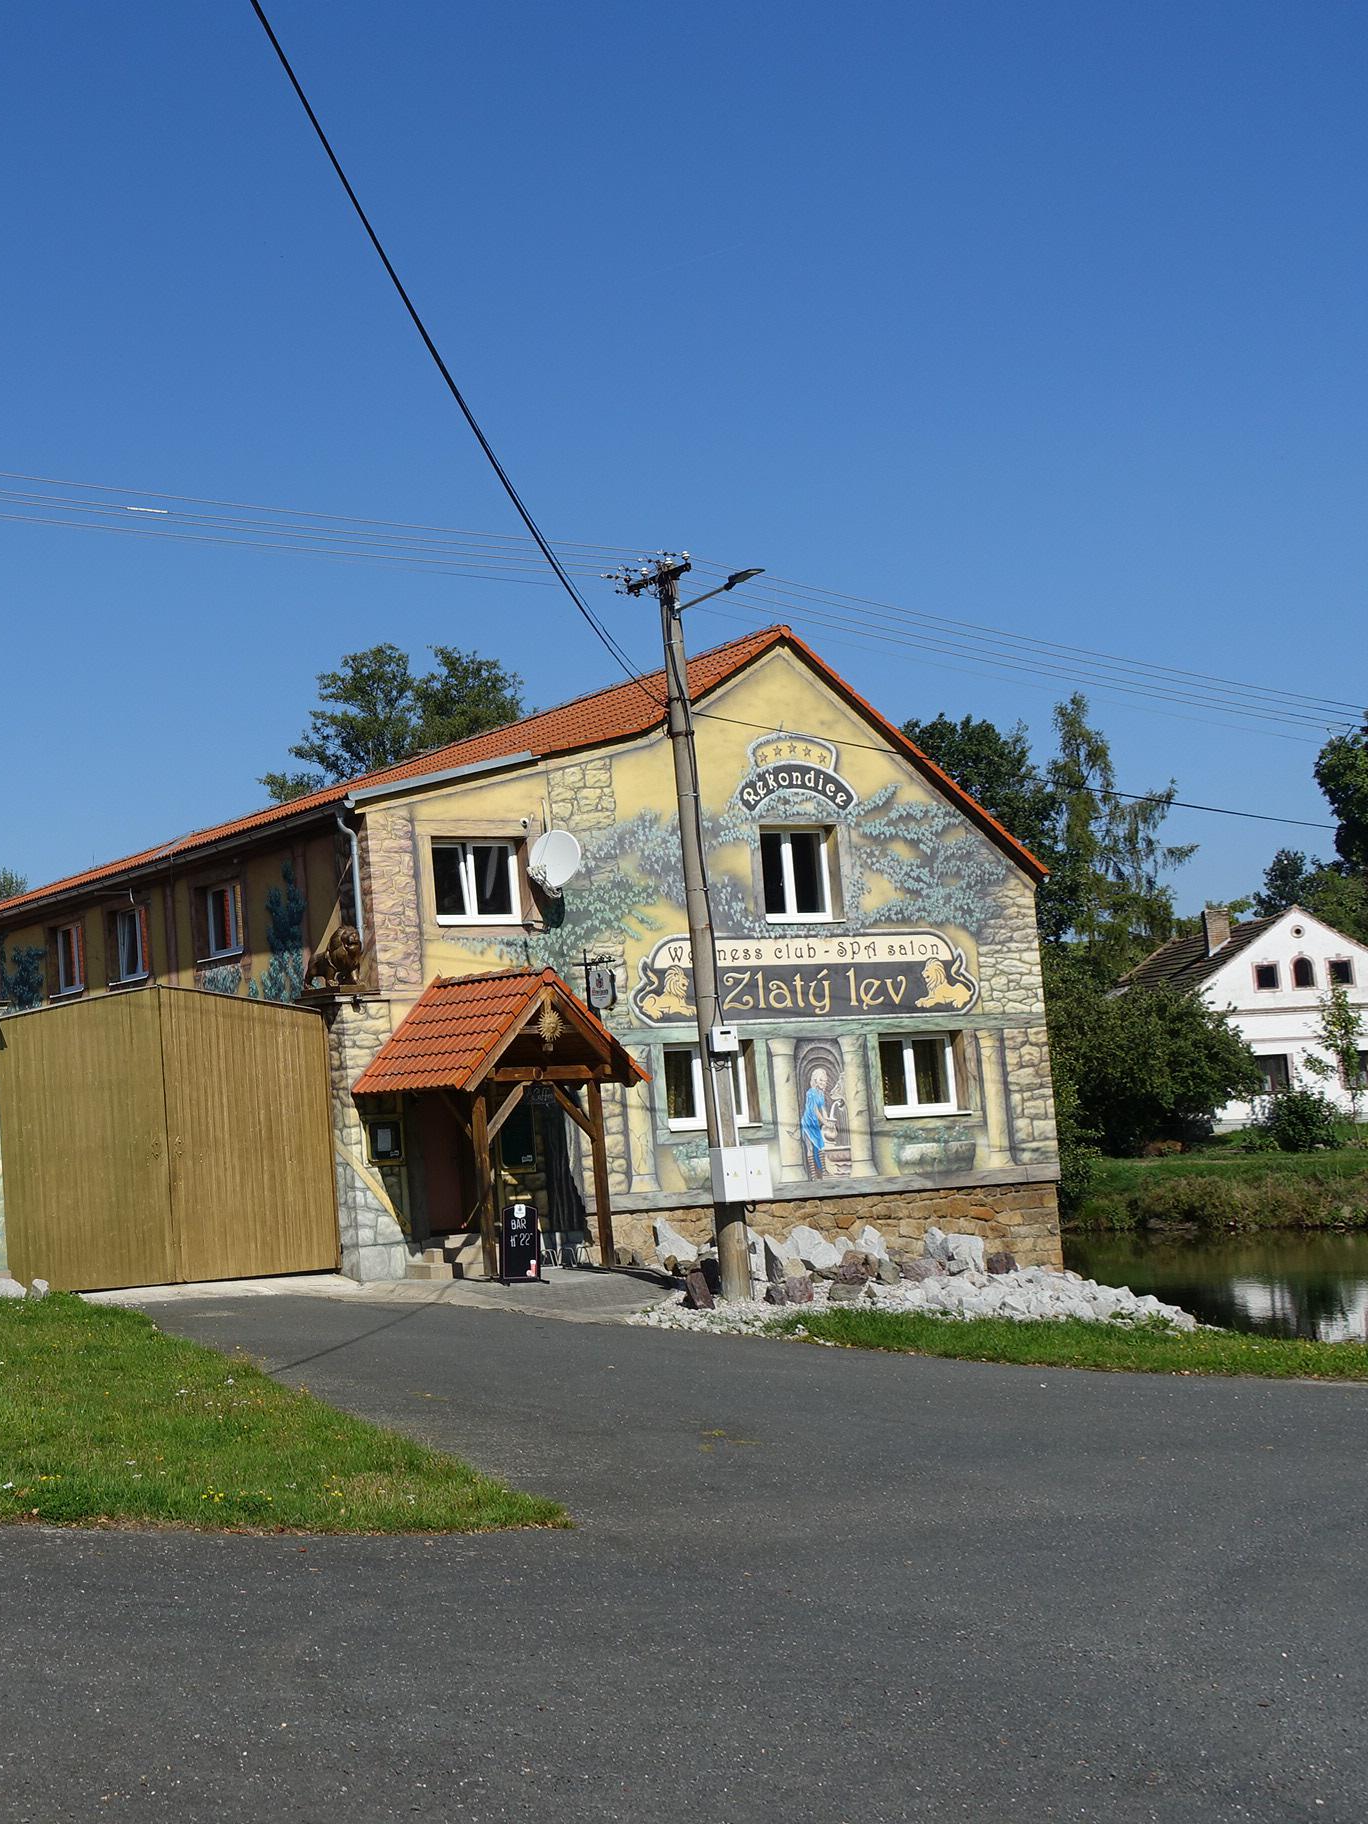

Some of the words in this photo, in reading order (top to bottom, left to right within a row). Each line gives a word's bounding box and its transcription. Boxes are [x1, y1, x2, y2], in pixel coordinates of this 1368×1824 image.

[743, 770, 848, 806] Rekondice
[668, 945, 763, 963] Wness
[774, 943, 817, 960] club
[836, 941, 877, 960] SPA
[887, 940, 939, 956] salon
[723, 967, 832, 1015] Zlatý
[845, 967, 907, 1011] lev
[511, 1219, 527, 1230] BAR
